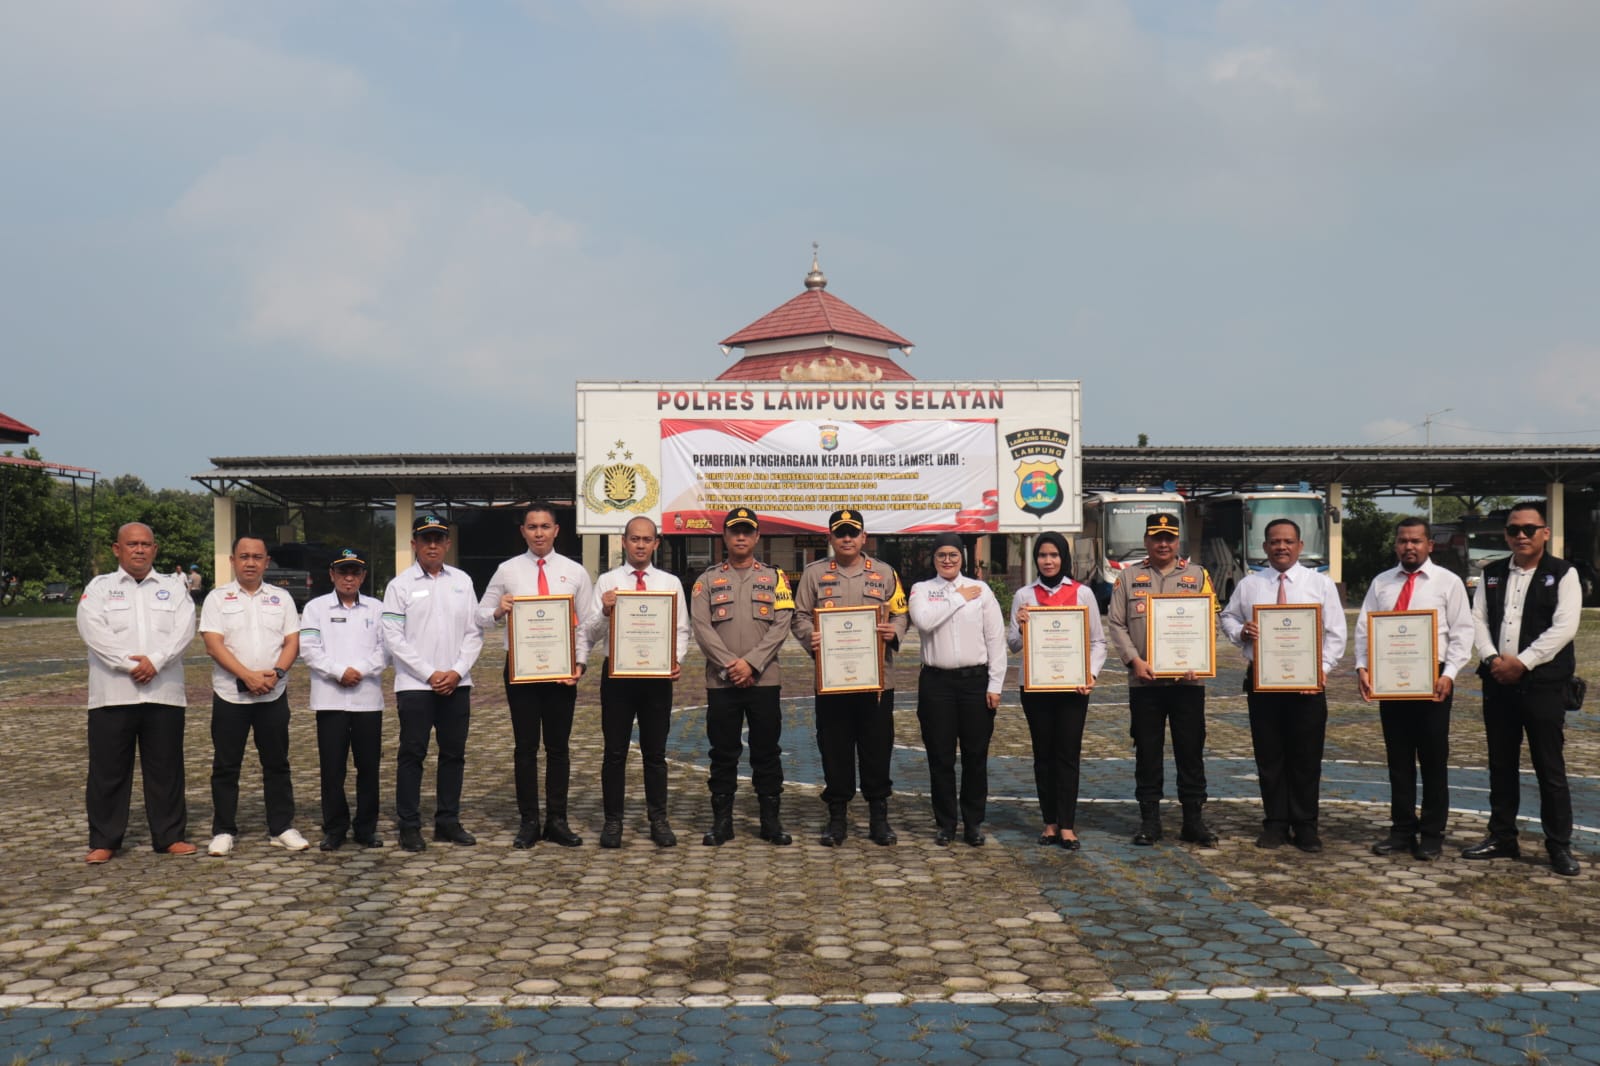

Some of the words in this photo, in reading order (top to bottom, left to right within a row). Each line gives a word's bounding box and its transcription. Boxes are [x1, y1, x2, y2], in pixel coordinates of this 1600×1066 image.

[657, 391, 754, 411] POLRES
[764, 391, 885, 410] LAMPUNG
[895, 390, 1004, 410] SELATAN
[1016, 430, 1058, 438] POLRES
[1014, 447, 1062, 457] LAMPUNG
[693, 454, 746, 467] PEMBERIAN
[750, 454, 819, 467] PENGHARGAAN
[821, 454, 858, 467] KEPADA
[861, 454, 896, 466] POLRES
[899, 454, 934, 466] LAMSEL
[937, 453, 959, 466] DARI
[752, 584, 774, 592] POLRI
